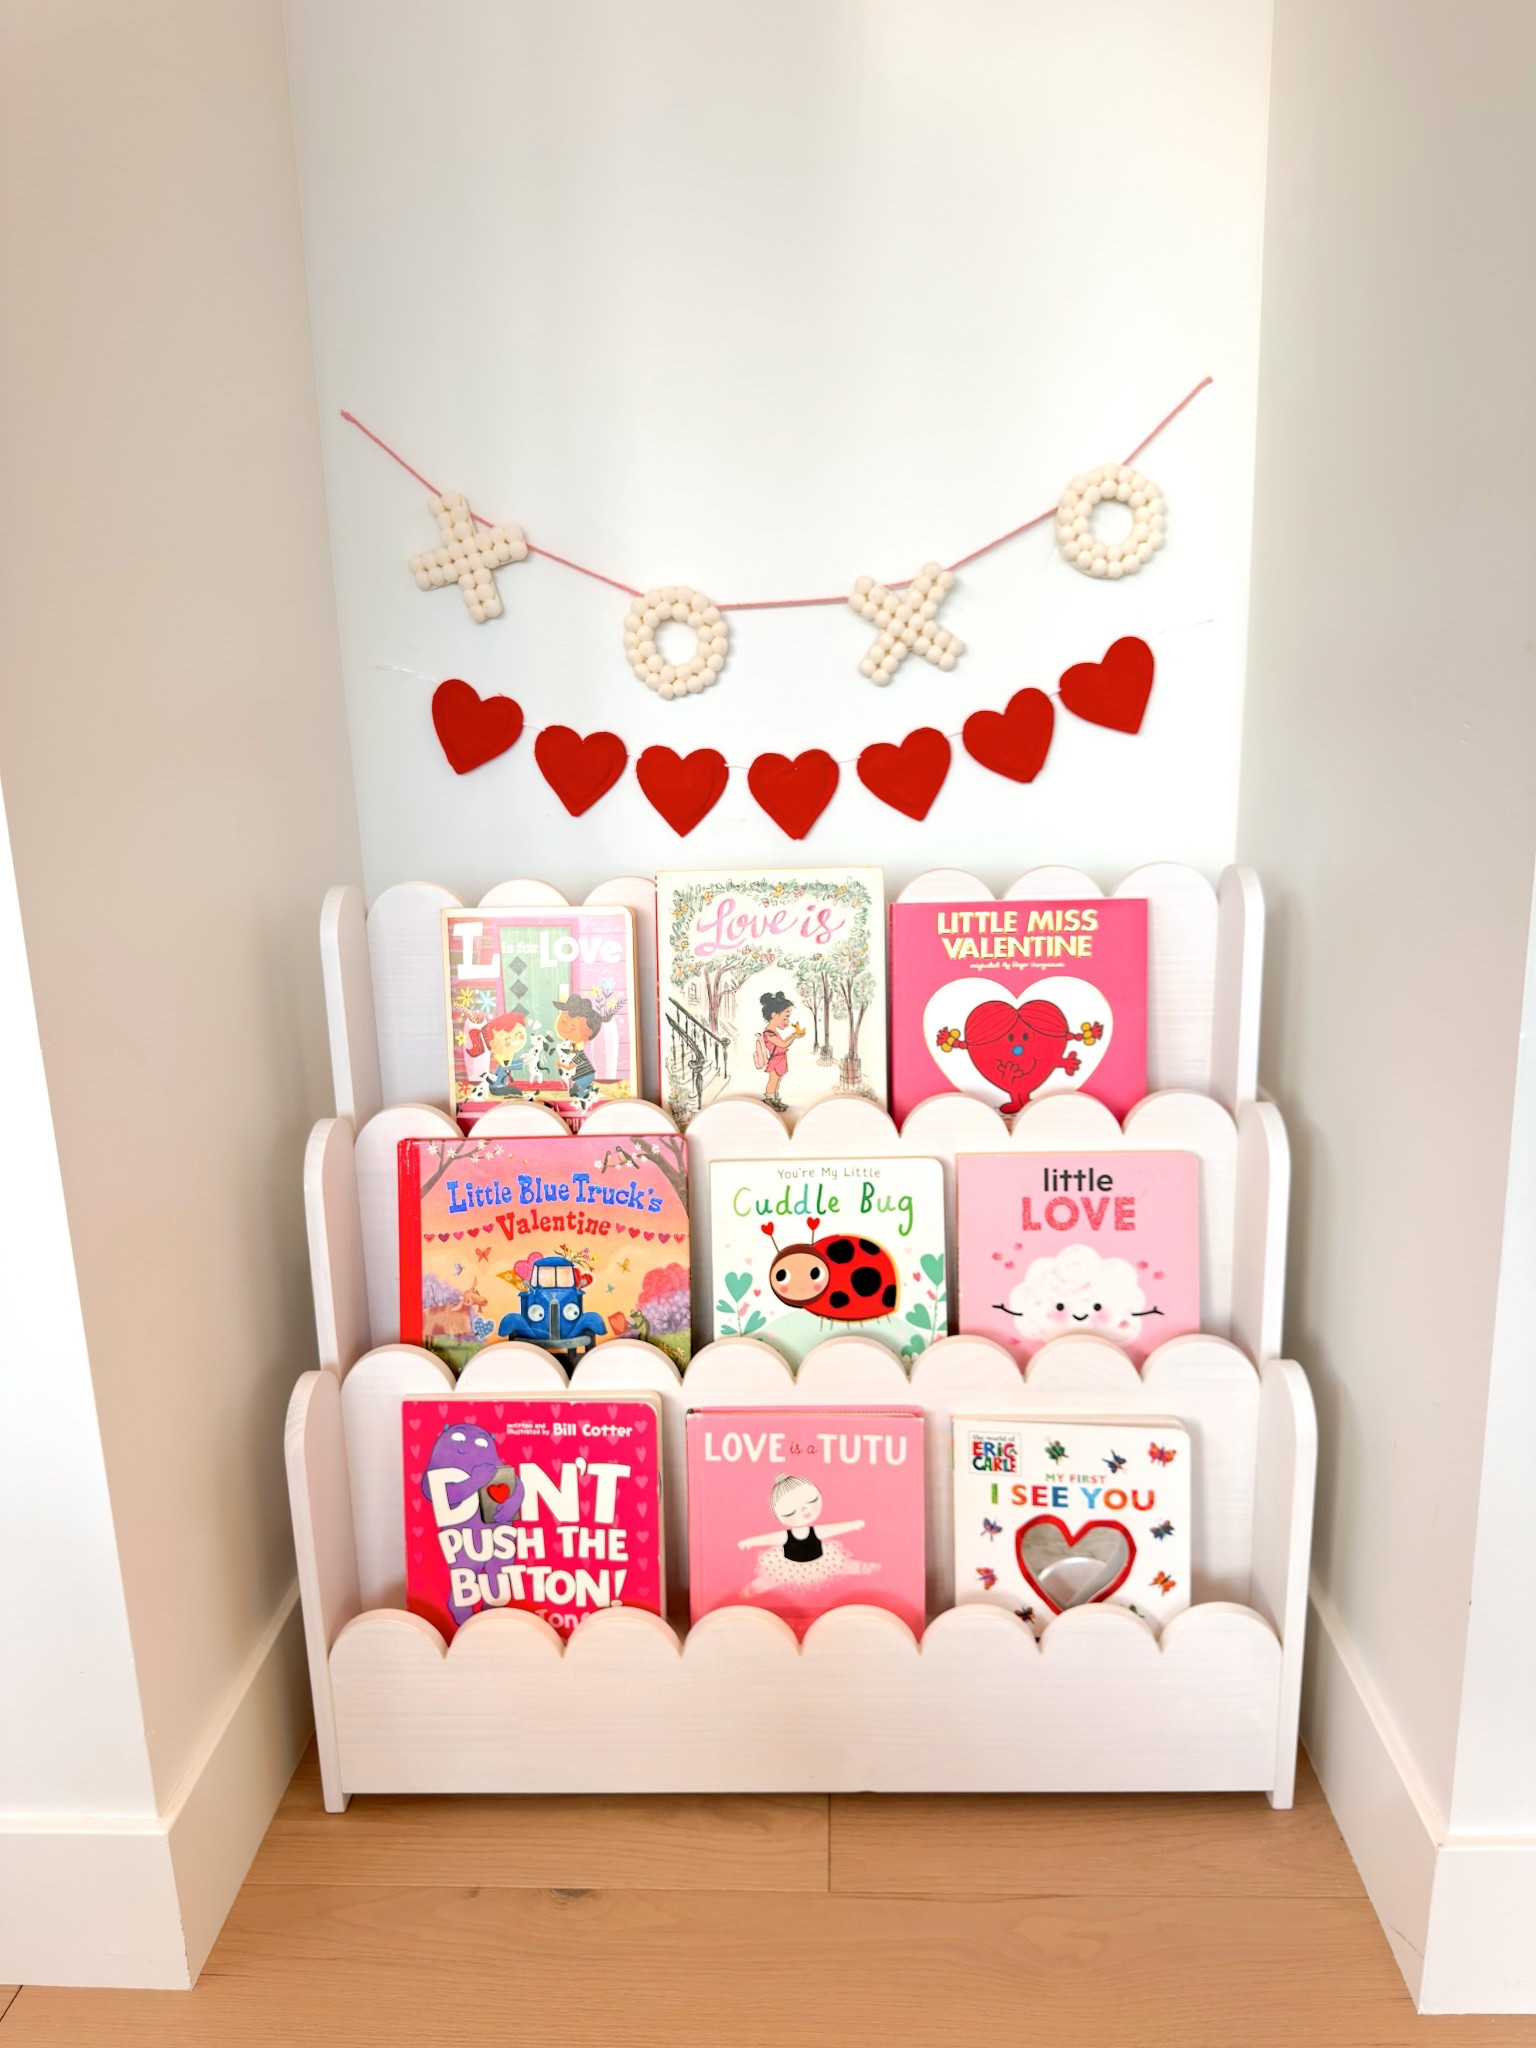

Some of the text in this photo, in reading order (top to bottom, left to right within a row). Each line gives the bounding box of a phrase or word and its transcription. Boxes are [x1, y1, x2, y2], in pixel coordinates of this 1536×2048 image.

[694, 898, 846, 957] Love is
[937, 909, 1099, 934] LITTLE MISS
[453, 922, 500, 979] L
[942, 935, 1094, 960] VALENTINE
[778, 1167, 881, 1180] You're My Little
[1043, 1167, 1114, 1192] little
[446, 1172, 664, 1214] Little Blue Truck's
[733, 1181, 914, 1237] Cuddle Bug
[495, 1208, 613, 1241] Valentine
[1021, 1196, 1136, 1231] LOVE
[552, 1422, 633, 1438] Bill Cotter
[704, 1432, 908, 1466] LOVE is a TUTU
[972, 1455, 1017, 1473] CARLE
[1045, 1473, 1107, 1484] MY FIRST
[990, 1483, 1155, 1511] I SEE YOU
[437, 1525, 630, 1565] PUSH THE
[450, 1564, 628, 1608] BUTTON!
